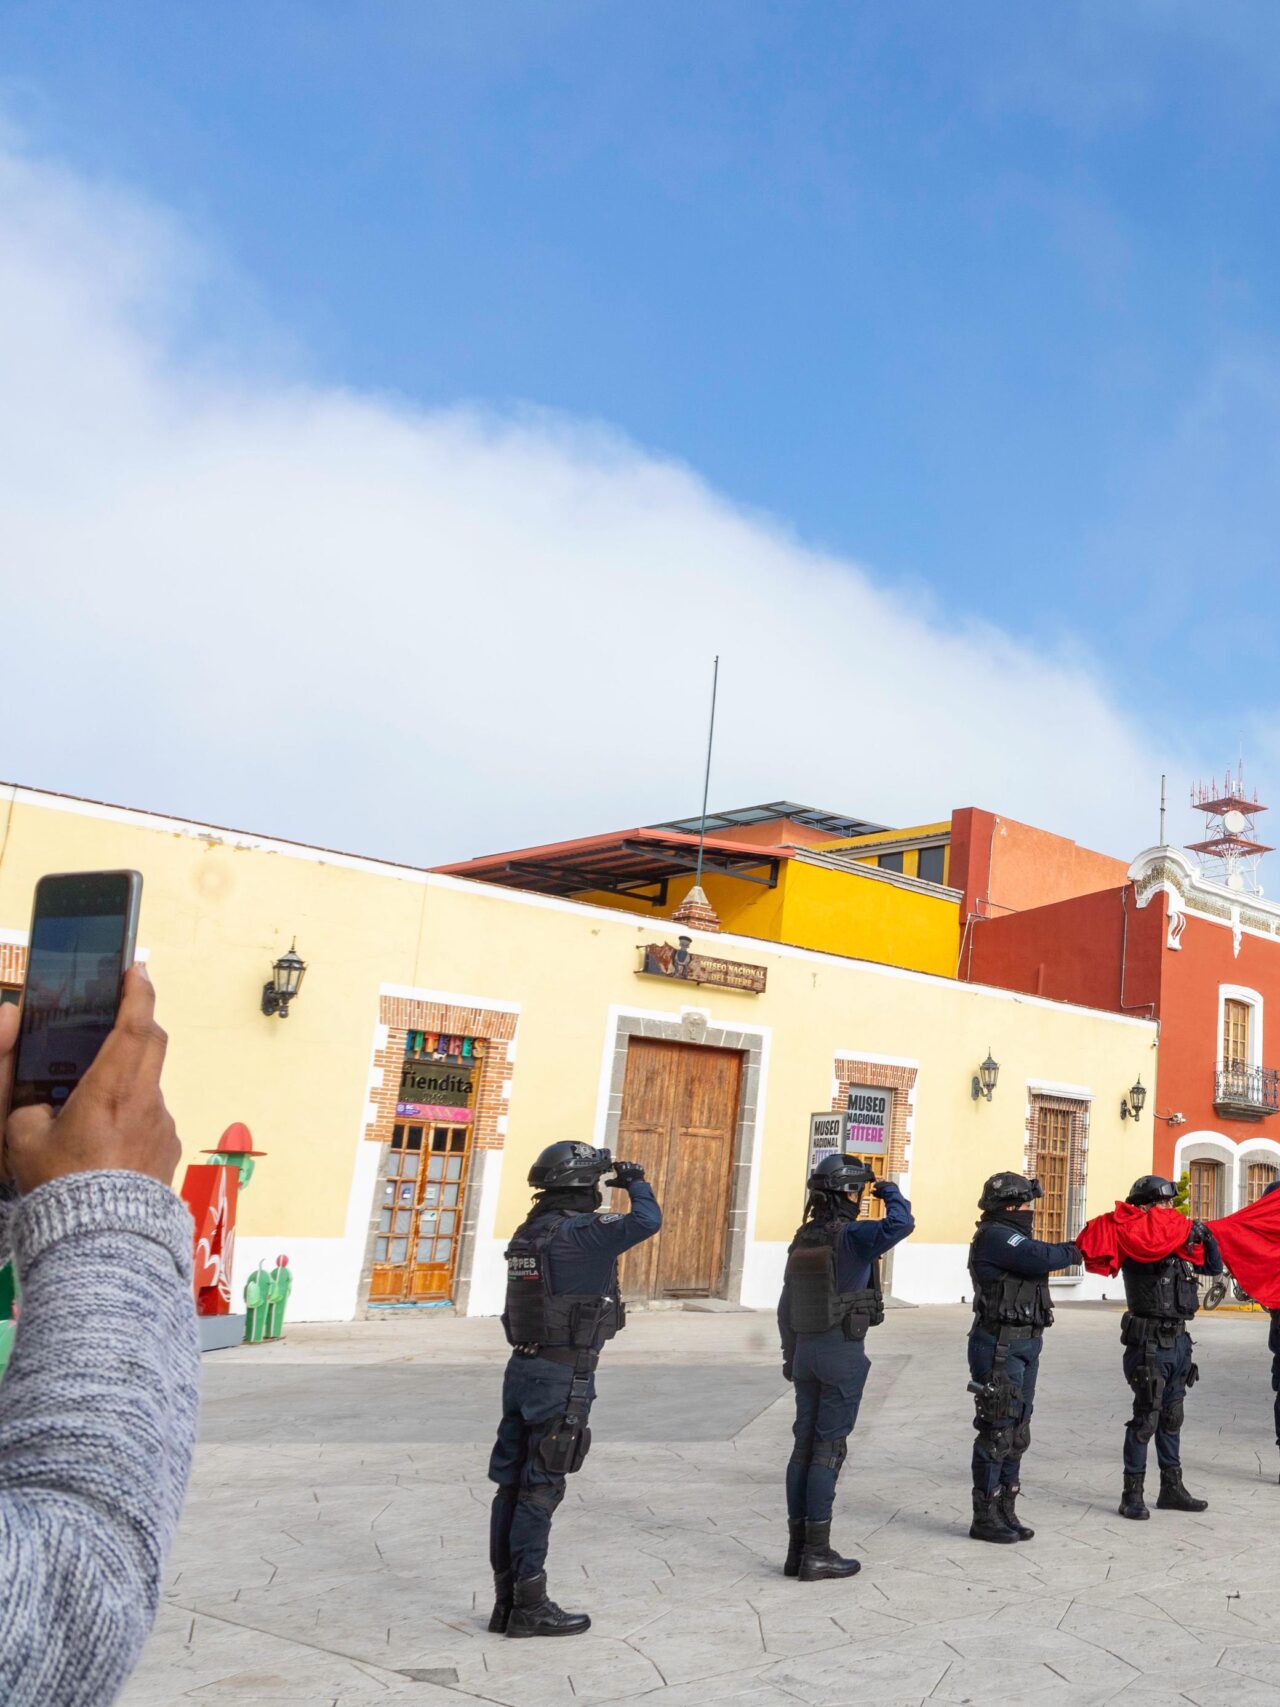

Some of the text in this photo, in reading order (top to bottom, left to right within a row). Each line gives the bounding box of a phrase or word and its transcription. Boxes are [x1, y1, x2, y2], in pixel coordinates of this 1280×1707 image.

[701, 960, 765, 979] MUSEO NACIONAL
[711, 974, 725, 982] DEL
[401, 1070, 473, 1094] Tiendita
[848, 1094, 885, 1114] MUSEO
[847, 1112, 885, 1126] NACIONAL
[814, 1120, 840, 1136] MUSEO
[813, 1137, 839, 1149] NACIONAL
